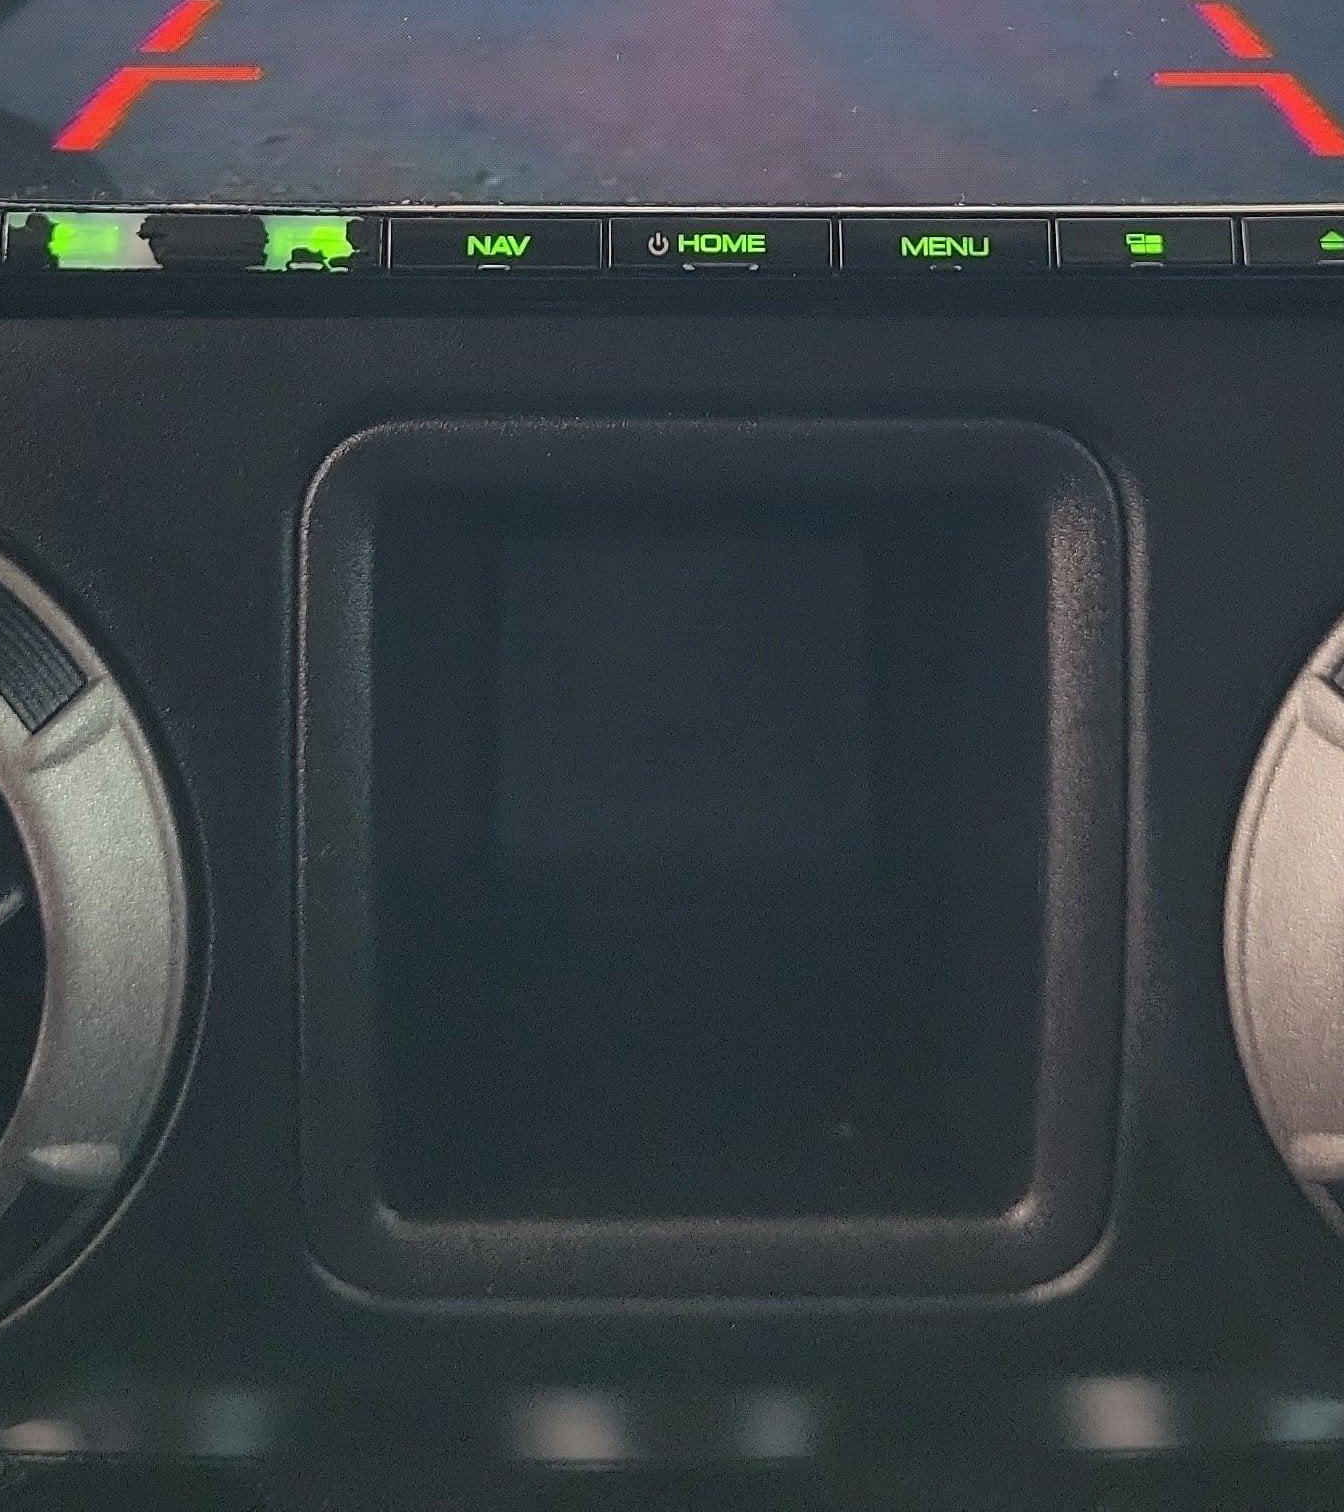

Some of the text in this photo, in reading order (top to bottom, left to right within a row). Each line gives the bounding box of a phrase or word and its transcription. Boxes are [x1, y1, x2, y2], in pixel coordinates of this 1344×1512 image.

[465, 234, 532, 259] NAV
[677, 232, 767, 255] HOME
[900, 235, 991, 259] MENU
